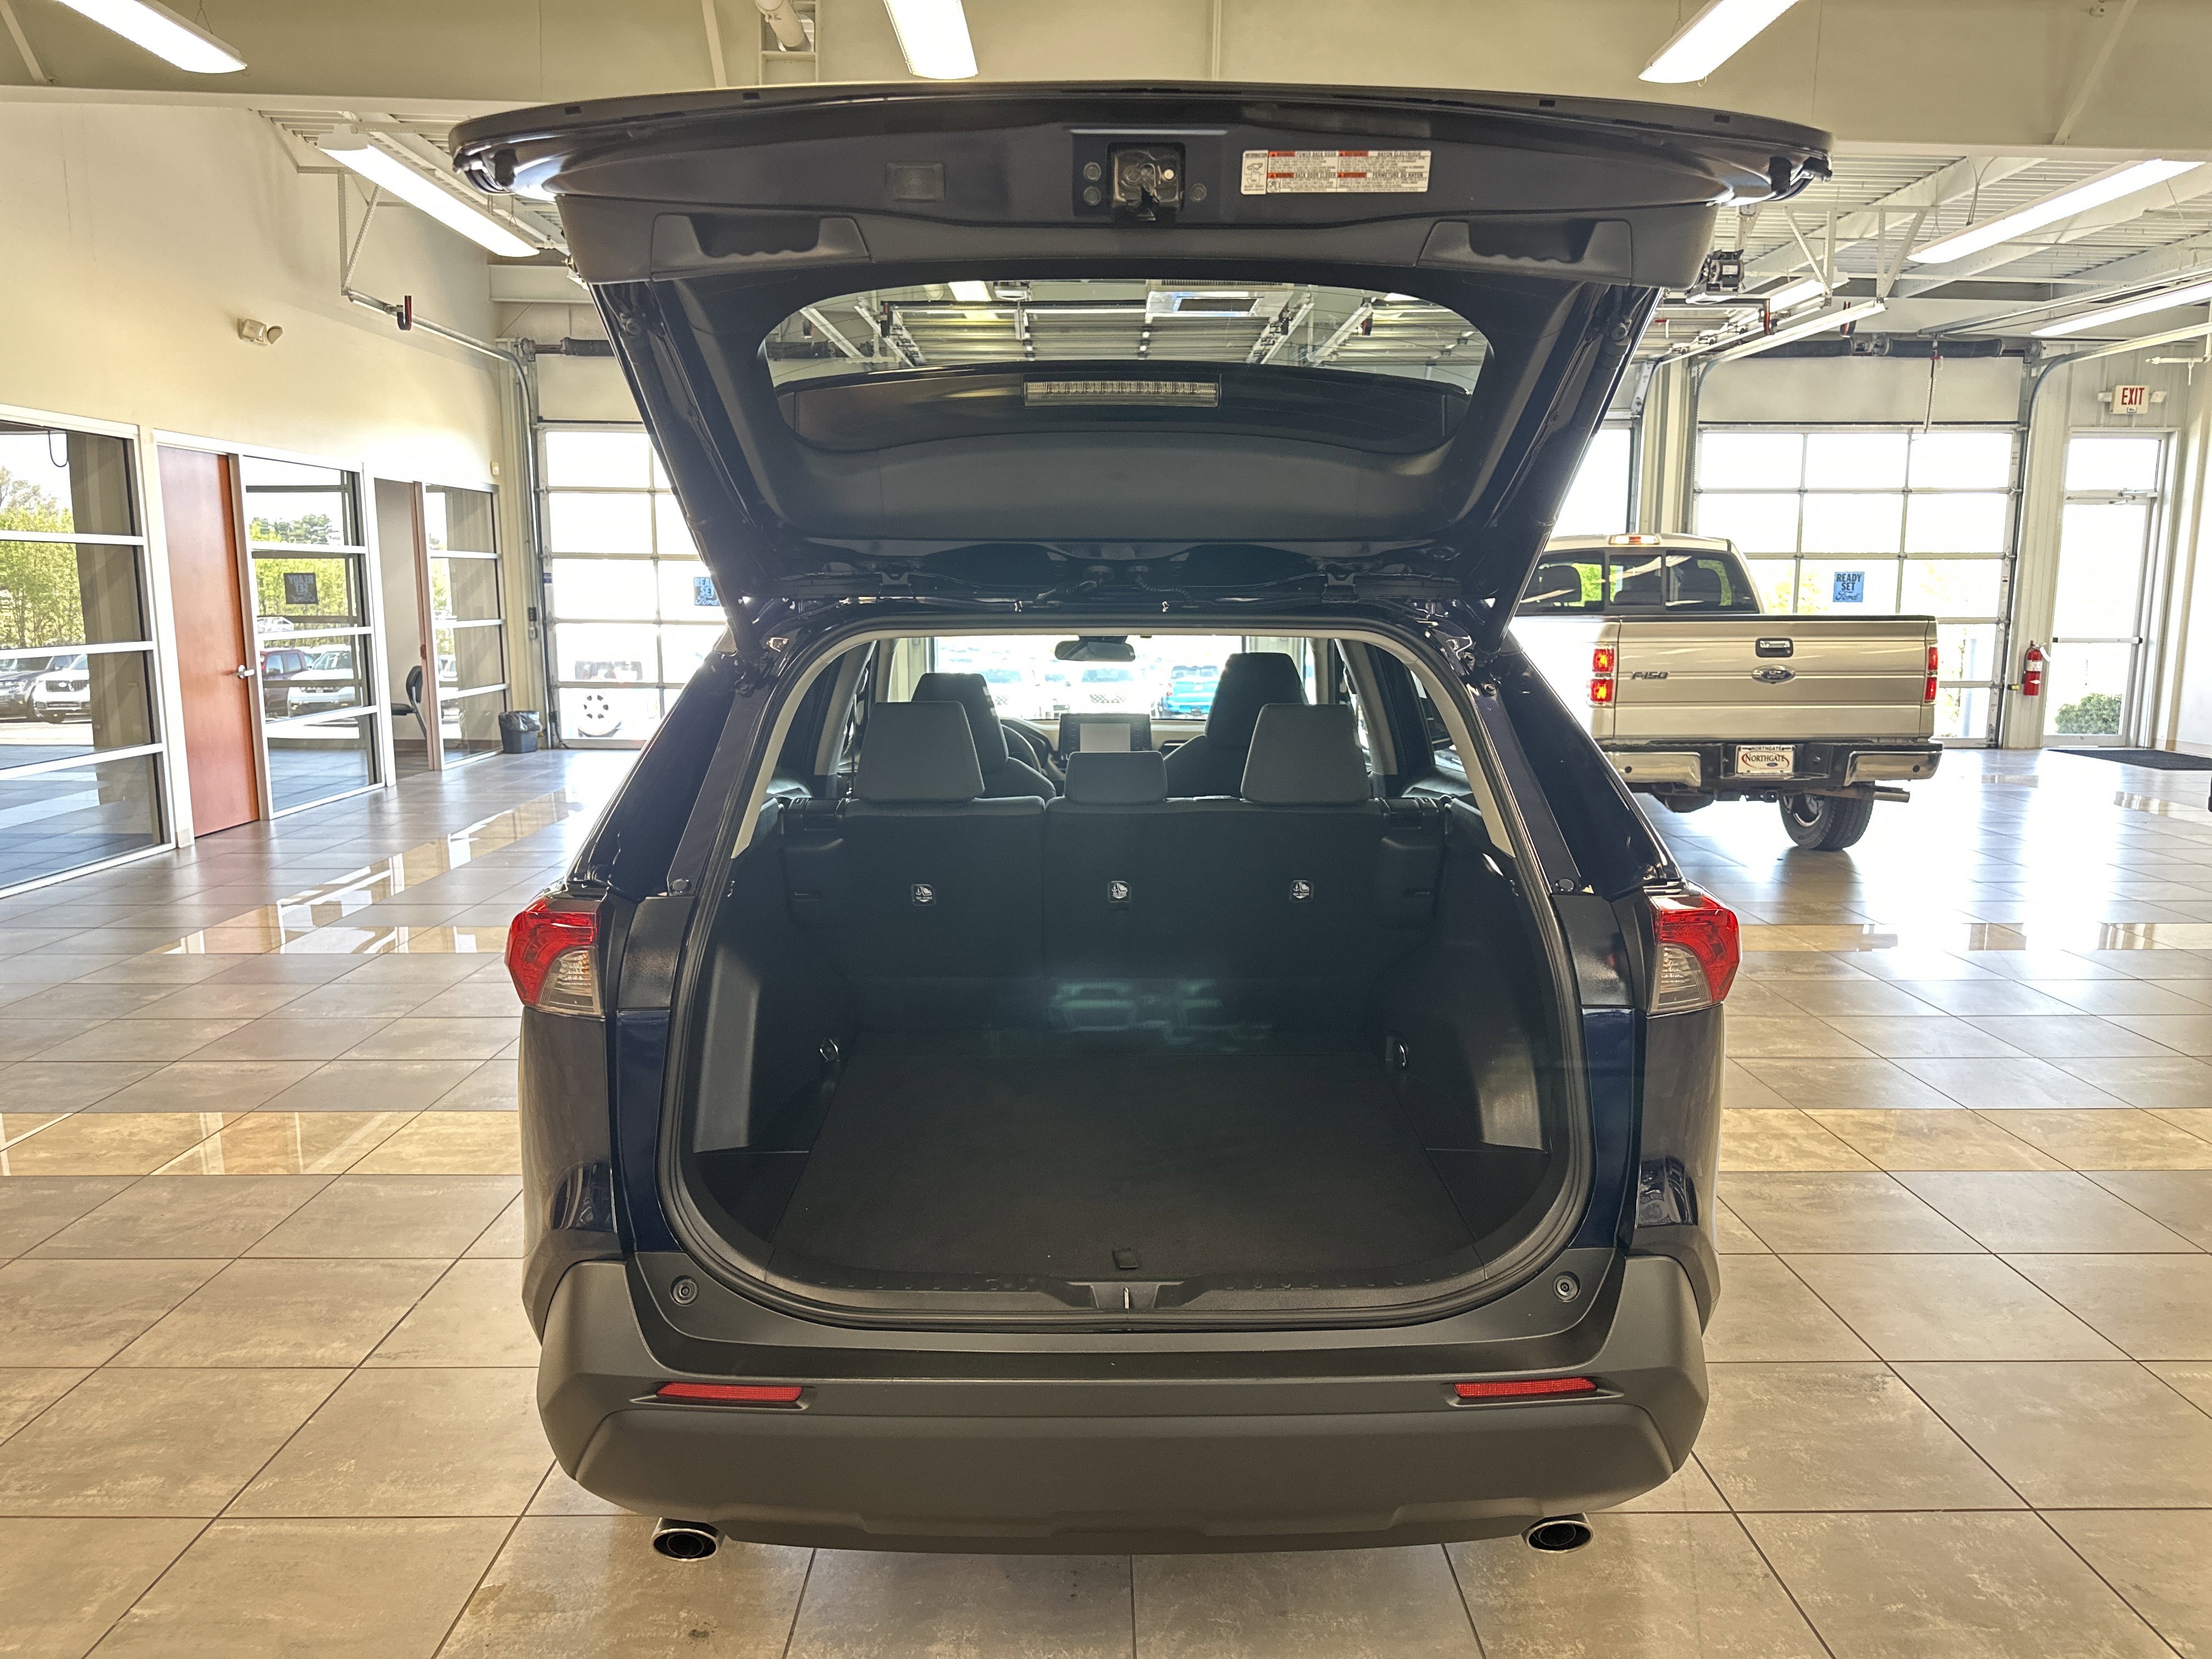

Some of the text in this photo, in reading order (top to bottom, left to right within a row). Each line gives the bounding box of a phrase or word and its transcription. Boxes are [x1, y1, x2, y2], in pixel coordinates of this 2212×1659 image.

[2121, 387, 2145, 405] EXIT
[694, 577, 713, 587] REA
[1836, 573, 1862, 582] READY
[1841, 582, 1856, 591] SET
[1835, 591, 1861, 600] Ford
[1745, 753, 1785, 762] NORTHGATE
